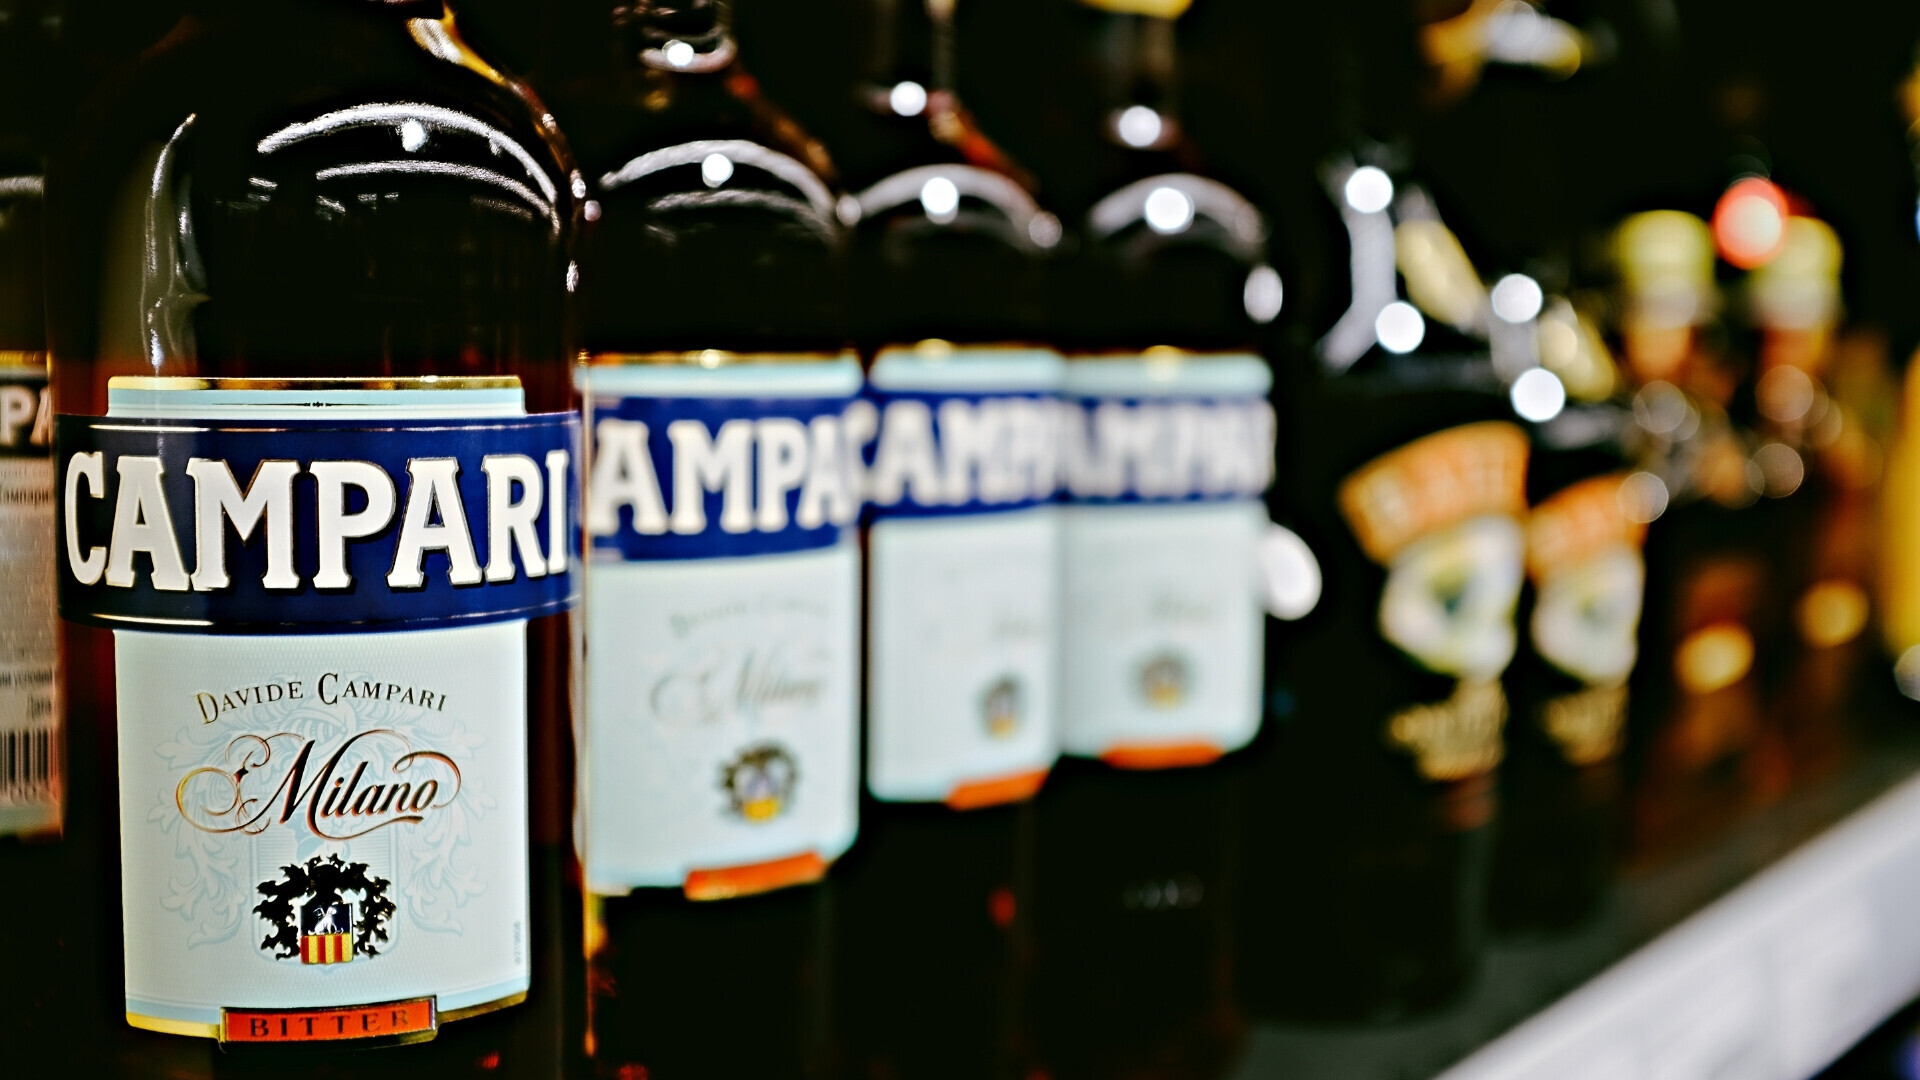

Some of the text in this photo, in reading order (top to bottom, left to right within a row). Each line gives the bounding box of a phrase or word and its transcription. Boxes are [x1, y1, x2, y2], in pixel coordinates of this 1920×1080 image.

[64, 450, 570, 593] CAMPARI
[194, 672, 448, 725] DAVIDE CAMPARI
[176, 729, 462, 841] Milano
[250, 1008, 410, 1038] BITTER
